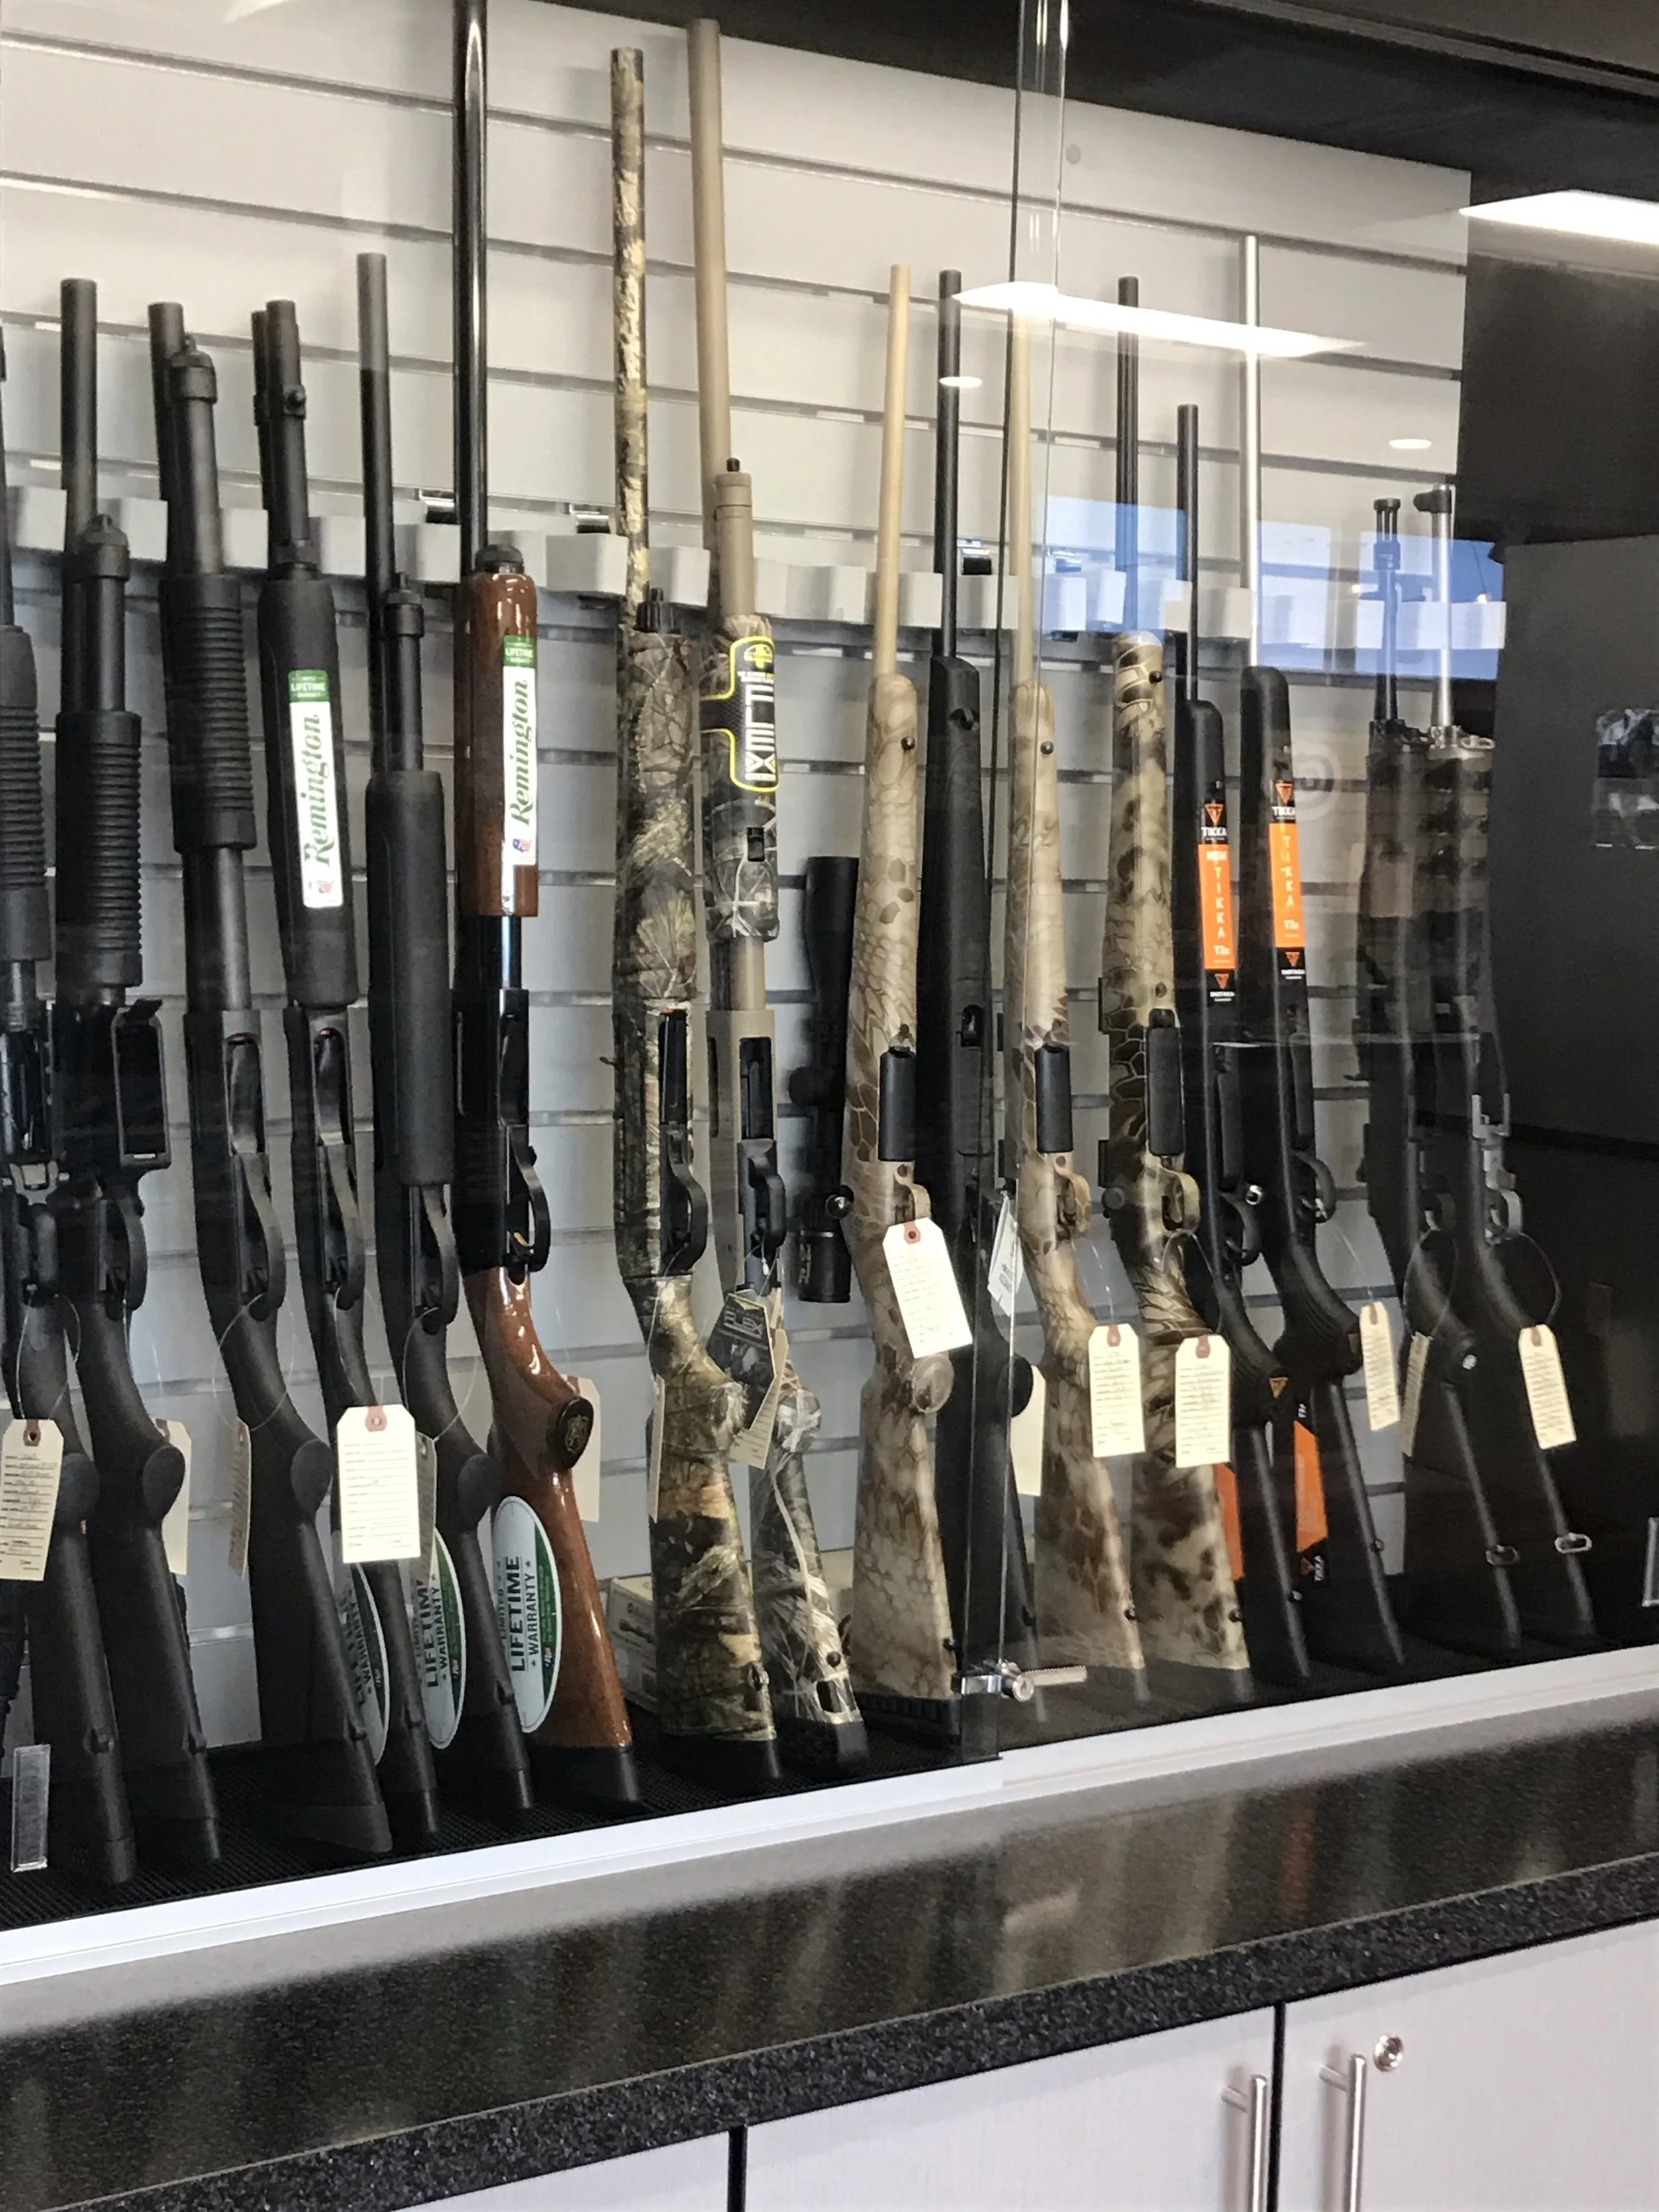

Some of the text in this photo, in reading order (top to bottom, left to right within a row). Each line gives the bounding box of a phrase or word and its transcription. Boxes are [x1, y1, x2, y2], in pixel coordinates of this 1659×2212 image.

[509, 680, 534, 826] Remington
[745, 684, 776, 773] FLEX
[301, 714, 335, 867] Remington
[1214, 866, 1226, 939] TIKKA
[431, 1586, 448, 1670] WARRANTY
[506, 1555, 526, 1671] LIFETIME
[524, 1572, 540, 1656] WARRANTY
